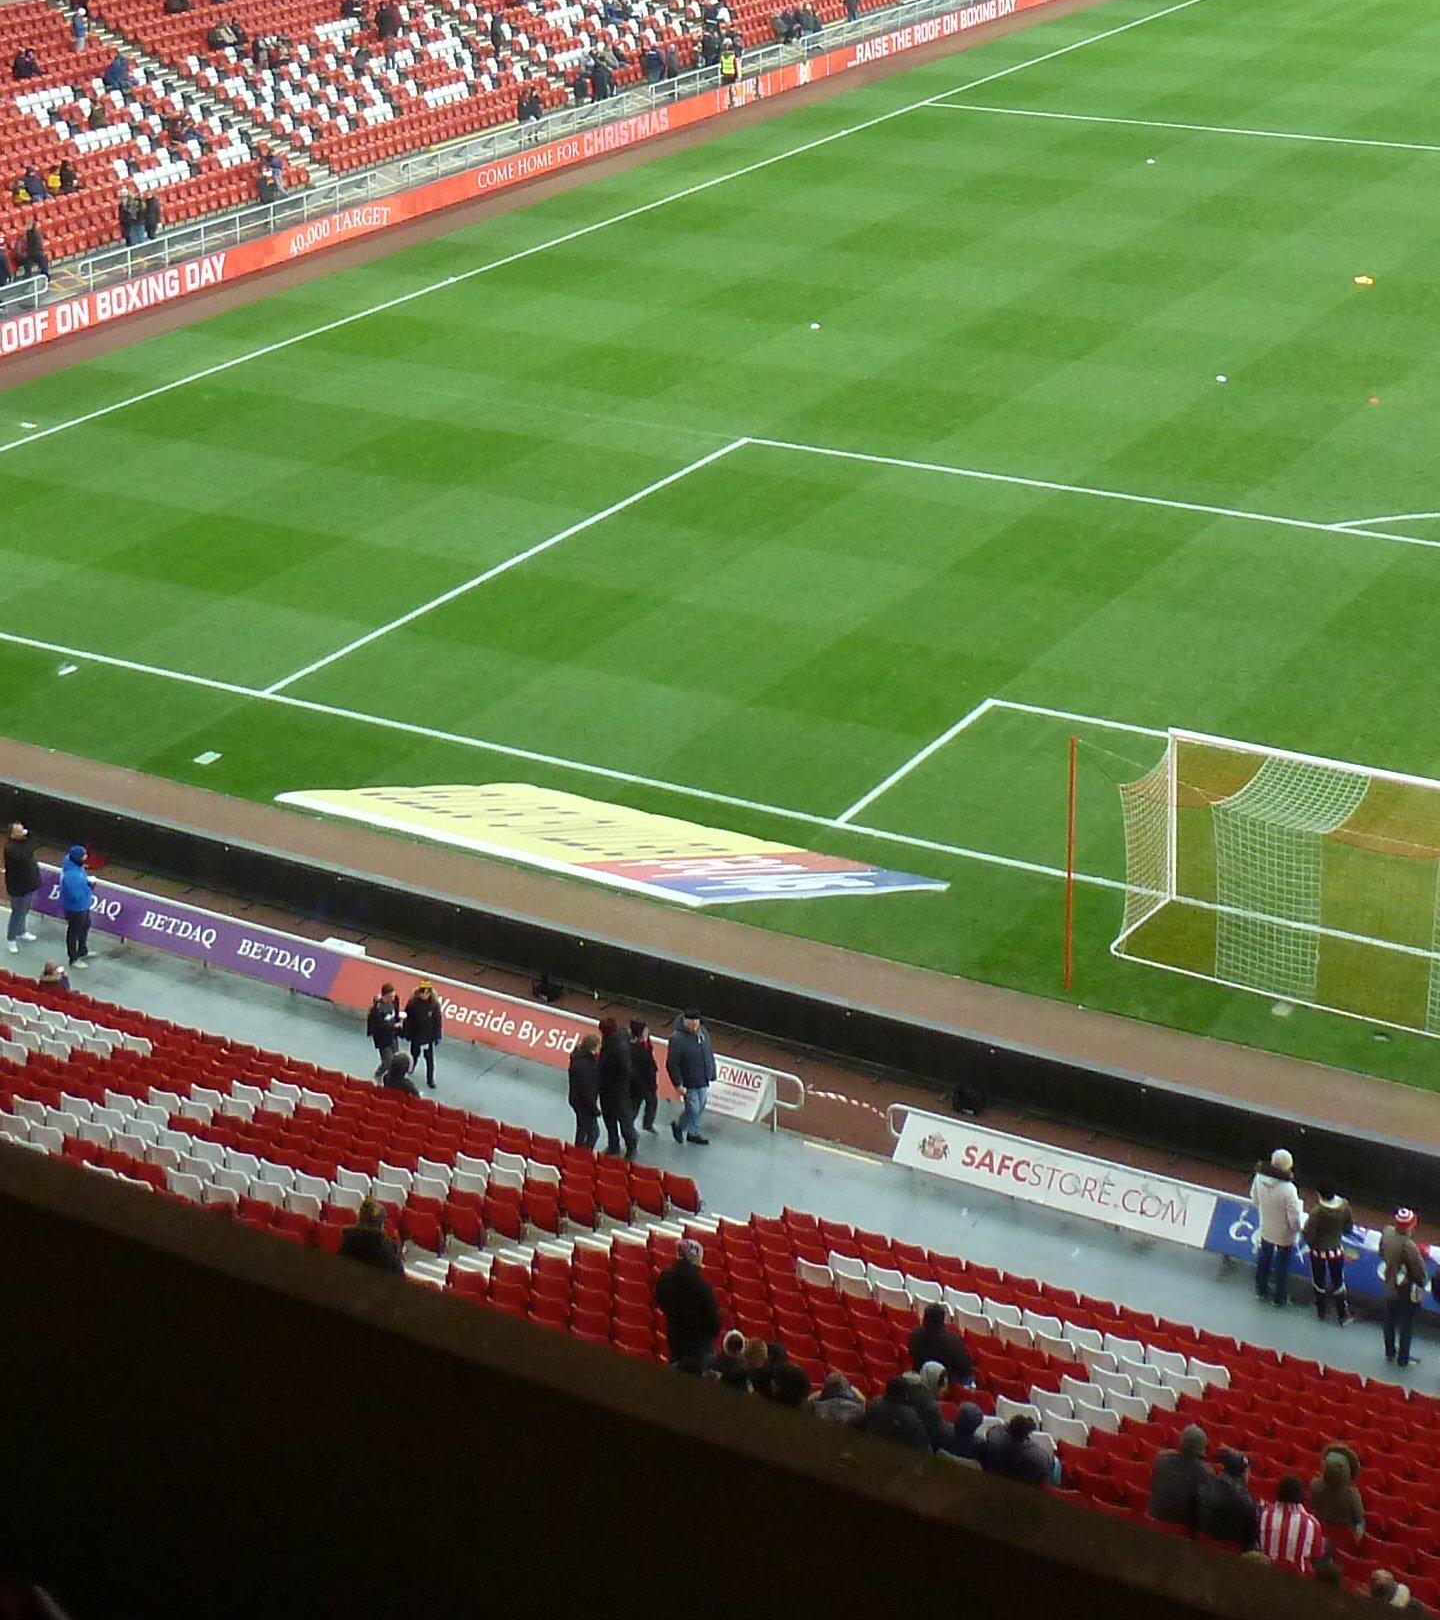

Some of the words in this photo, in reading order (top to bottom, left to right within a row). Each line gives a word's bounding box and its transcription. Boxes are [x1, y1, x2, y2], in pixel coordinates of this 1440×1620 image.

[890, 29, 913, 53] THE
[913, 18, 941, 45] ROOF
[943, 10, 960, 34] ON
[960, 0, 998, 30] BOXING
[477, 163, 515, 188] COME
[518, 151, 554, 175] HOME
[557, 140, 580, 160] FOR
[583, 107, 669, 157] CHRISTMAS
[290, 219, 331, 256] 40,000
[332, 207, 391, 233] TARGET
[55, 297, 90, 334] ON
[96, 268, 180, 321] BOXING
[184, 252, 226, 291] DAY
[141, 910, 217, 950] BETDAQ
[237, 938, 316, 979] BETDAQ
[518, 1020, 544, 1048] By
[545, 1028, 582, 1054] Sid
[718, 1065, 763, 1089] RNING
[961, 1144, 1188, 1228] SAFCSTORE.COM
